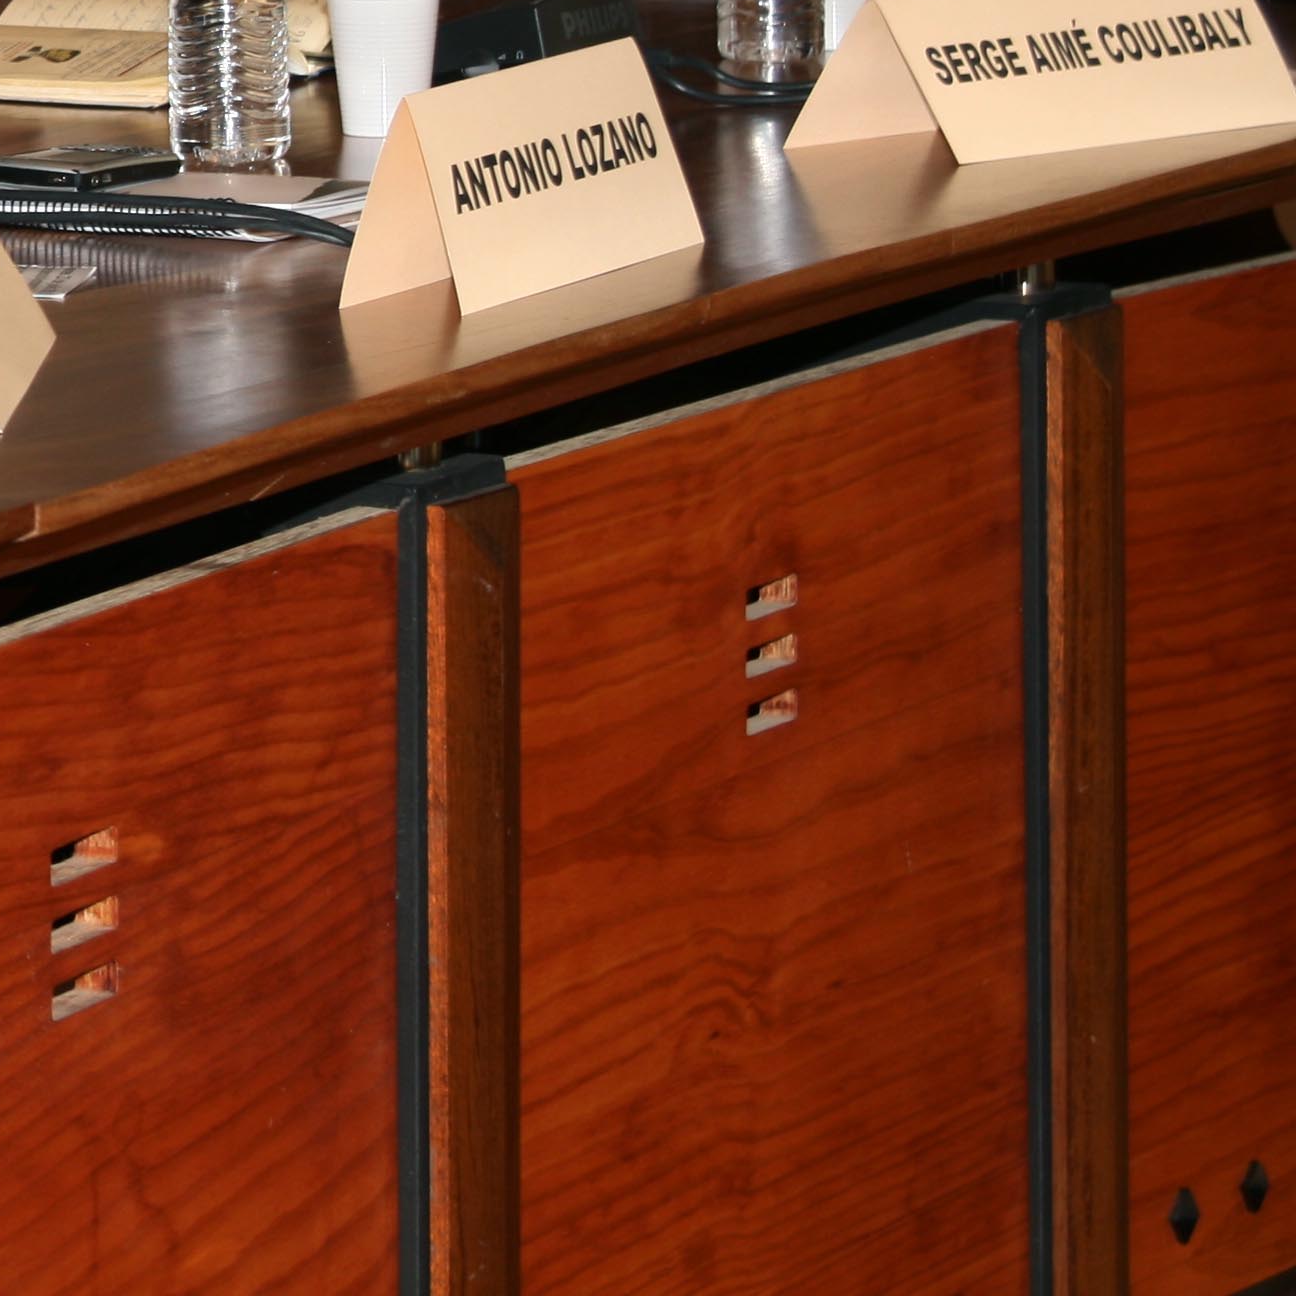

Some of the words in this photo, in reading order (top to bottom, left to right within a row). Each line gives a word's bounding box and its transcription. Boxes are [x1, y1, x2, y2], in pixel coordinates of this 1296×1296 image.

[561, 1, 629, 40] PHILIPS
[925, 37, 1028, 86] SERGE
[1025, 19, 1102, 74] AIMÉ
[1096, 7, 1252, 64] COULIBALY
[451, 138, 563, 215] ANTONIO
[561, 112, 657, 181] LOZANO
